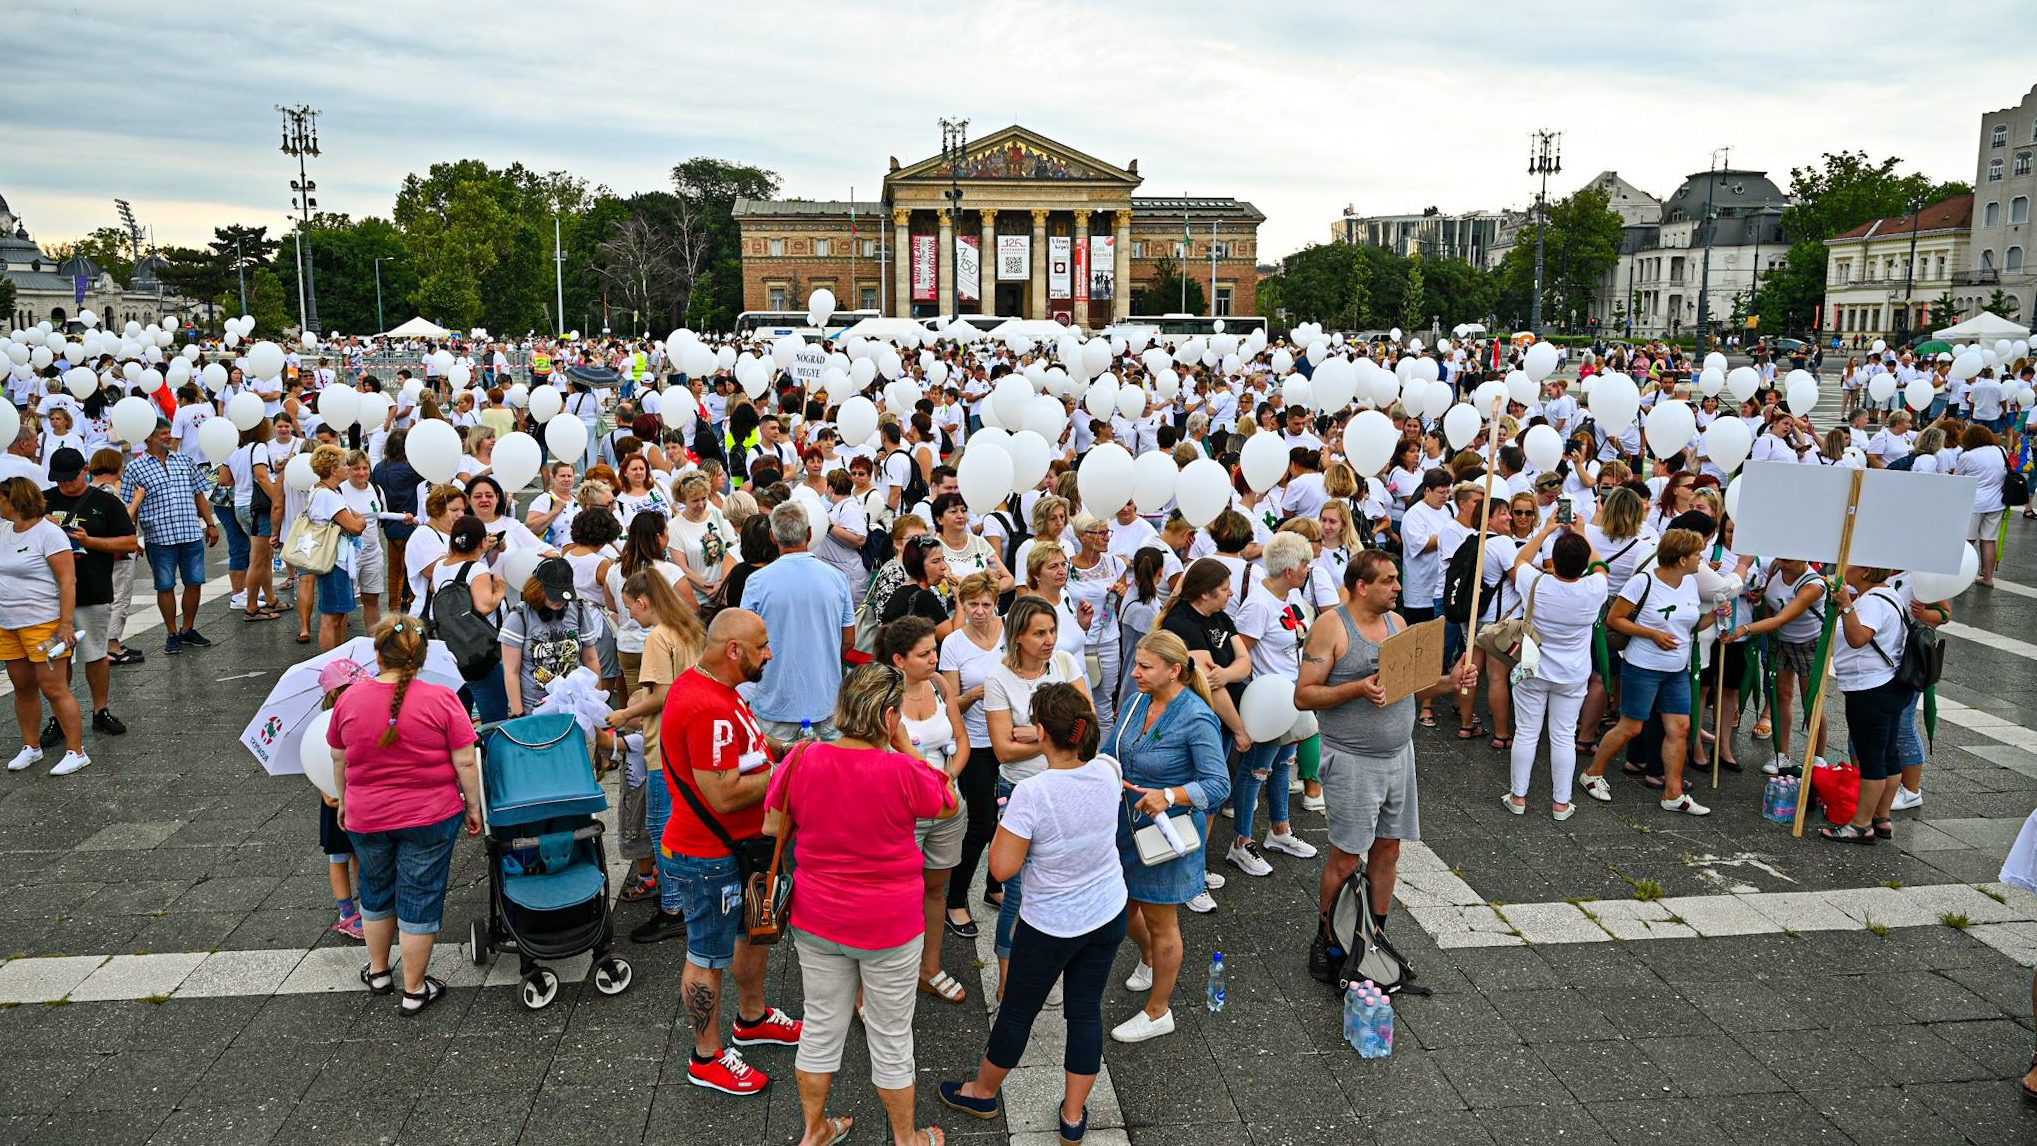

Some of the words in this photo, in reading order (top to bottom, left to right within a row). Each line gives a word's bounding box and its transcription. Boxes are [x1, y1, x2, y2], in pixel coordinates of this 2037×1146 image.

[913, 252, 921, 265] WE
[960, 258, 978, 275] 150
[913, 266, 921, 283] WHO
[796, 352, 826, 364] NÓGRÁD
[797, 367, 821, 378] MEGYE
